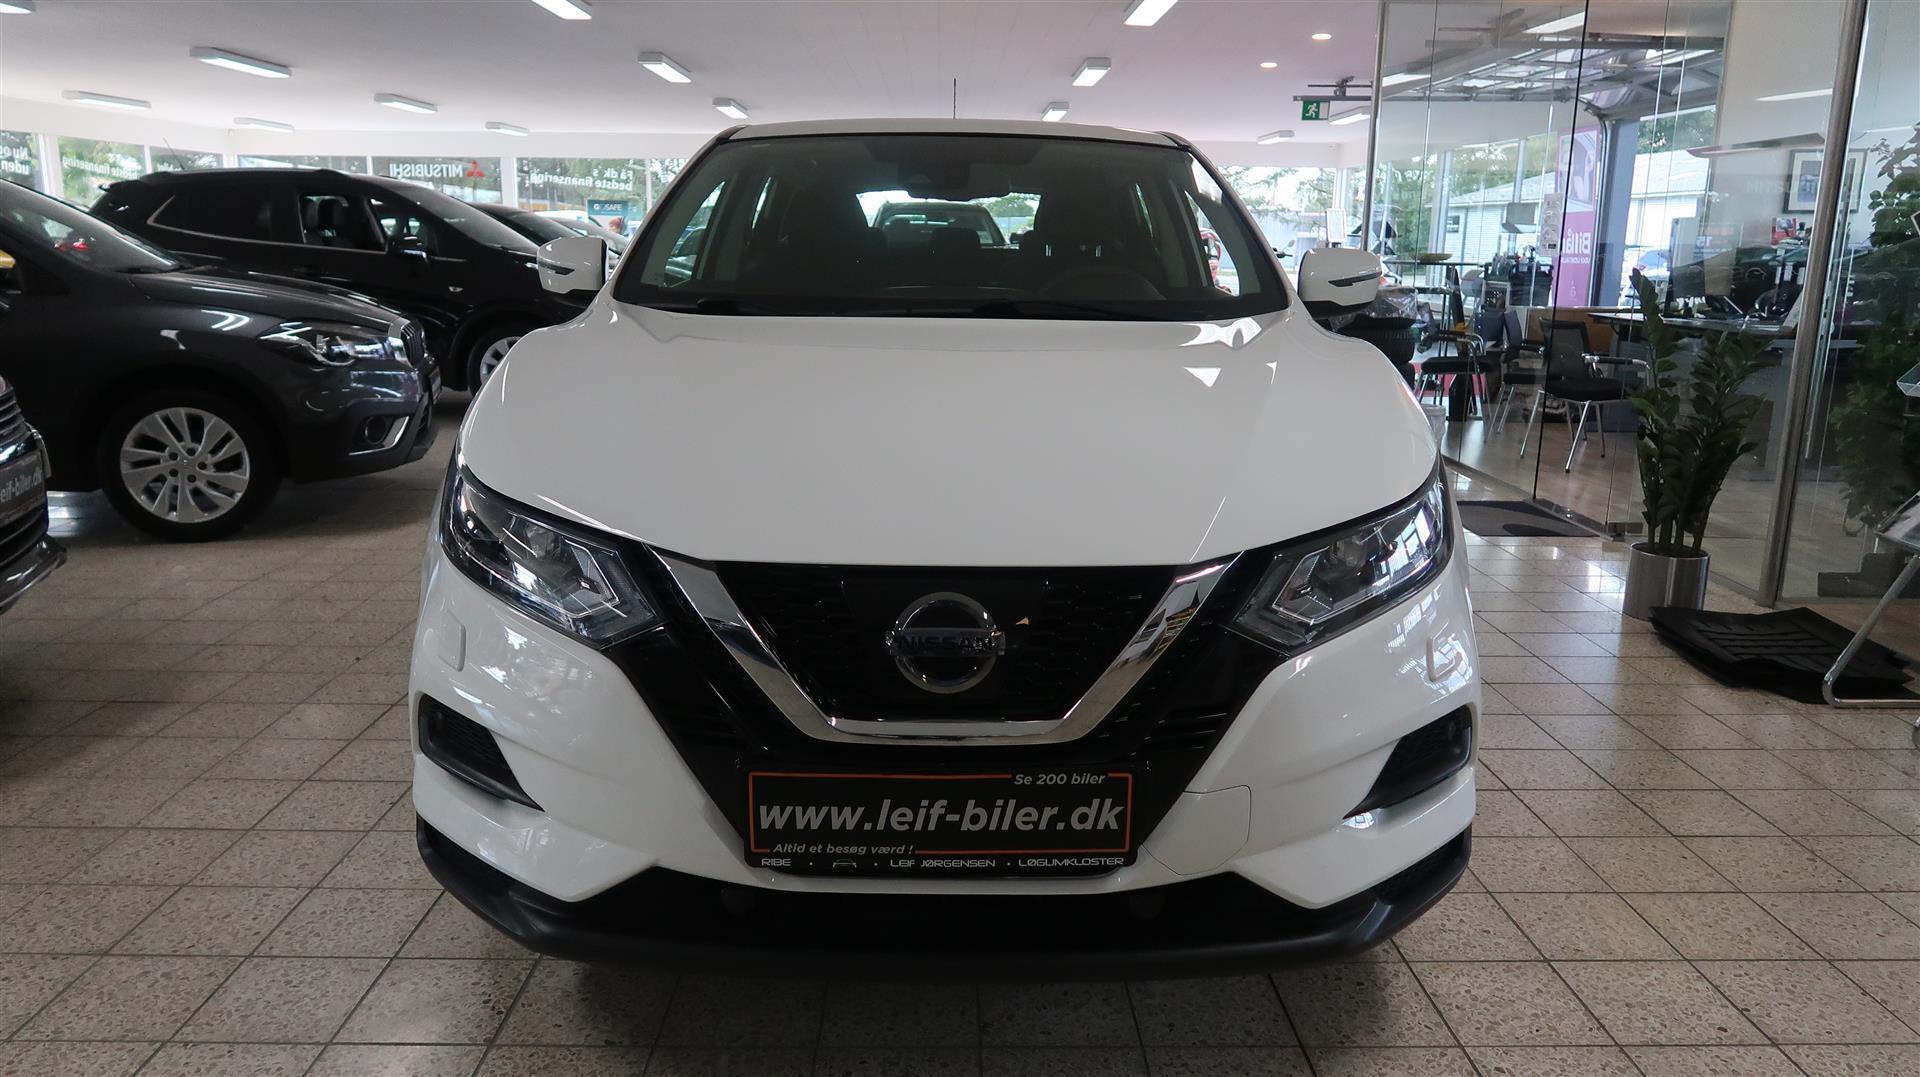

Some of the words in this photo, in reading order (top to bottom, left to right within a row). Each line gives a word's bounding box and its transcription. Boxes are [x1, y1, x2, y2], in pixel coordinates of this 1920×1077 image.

[899, 635, 996, 651] NISSAN
[1014, 773, 1033, 785] Se
[1036, 773, 1067, 785] 200
[1071, 772, 1106, 785] biler
[759, 798, 1125, 832] www.leif-biler.dk
[772, 843, 806, 854] Altid
[809, 844, 823, 854] et
[826, 843, 867, 856] besøg
[871, 844, 906, 855] værd
[761, 858, 792, 867] RIBE
[890, 859, 915, 868] LEIF
[920, 858, 996, 868] JØRGENSEN
[1018, 857, 1124, 867] LØGUMKLOSTER
